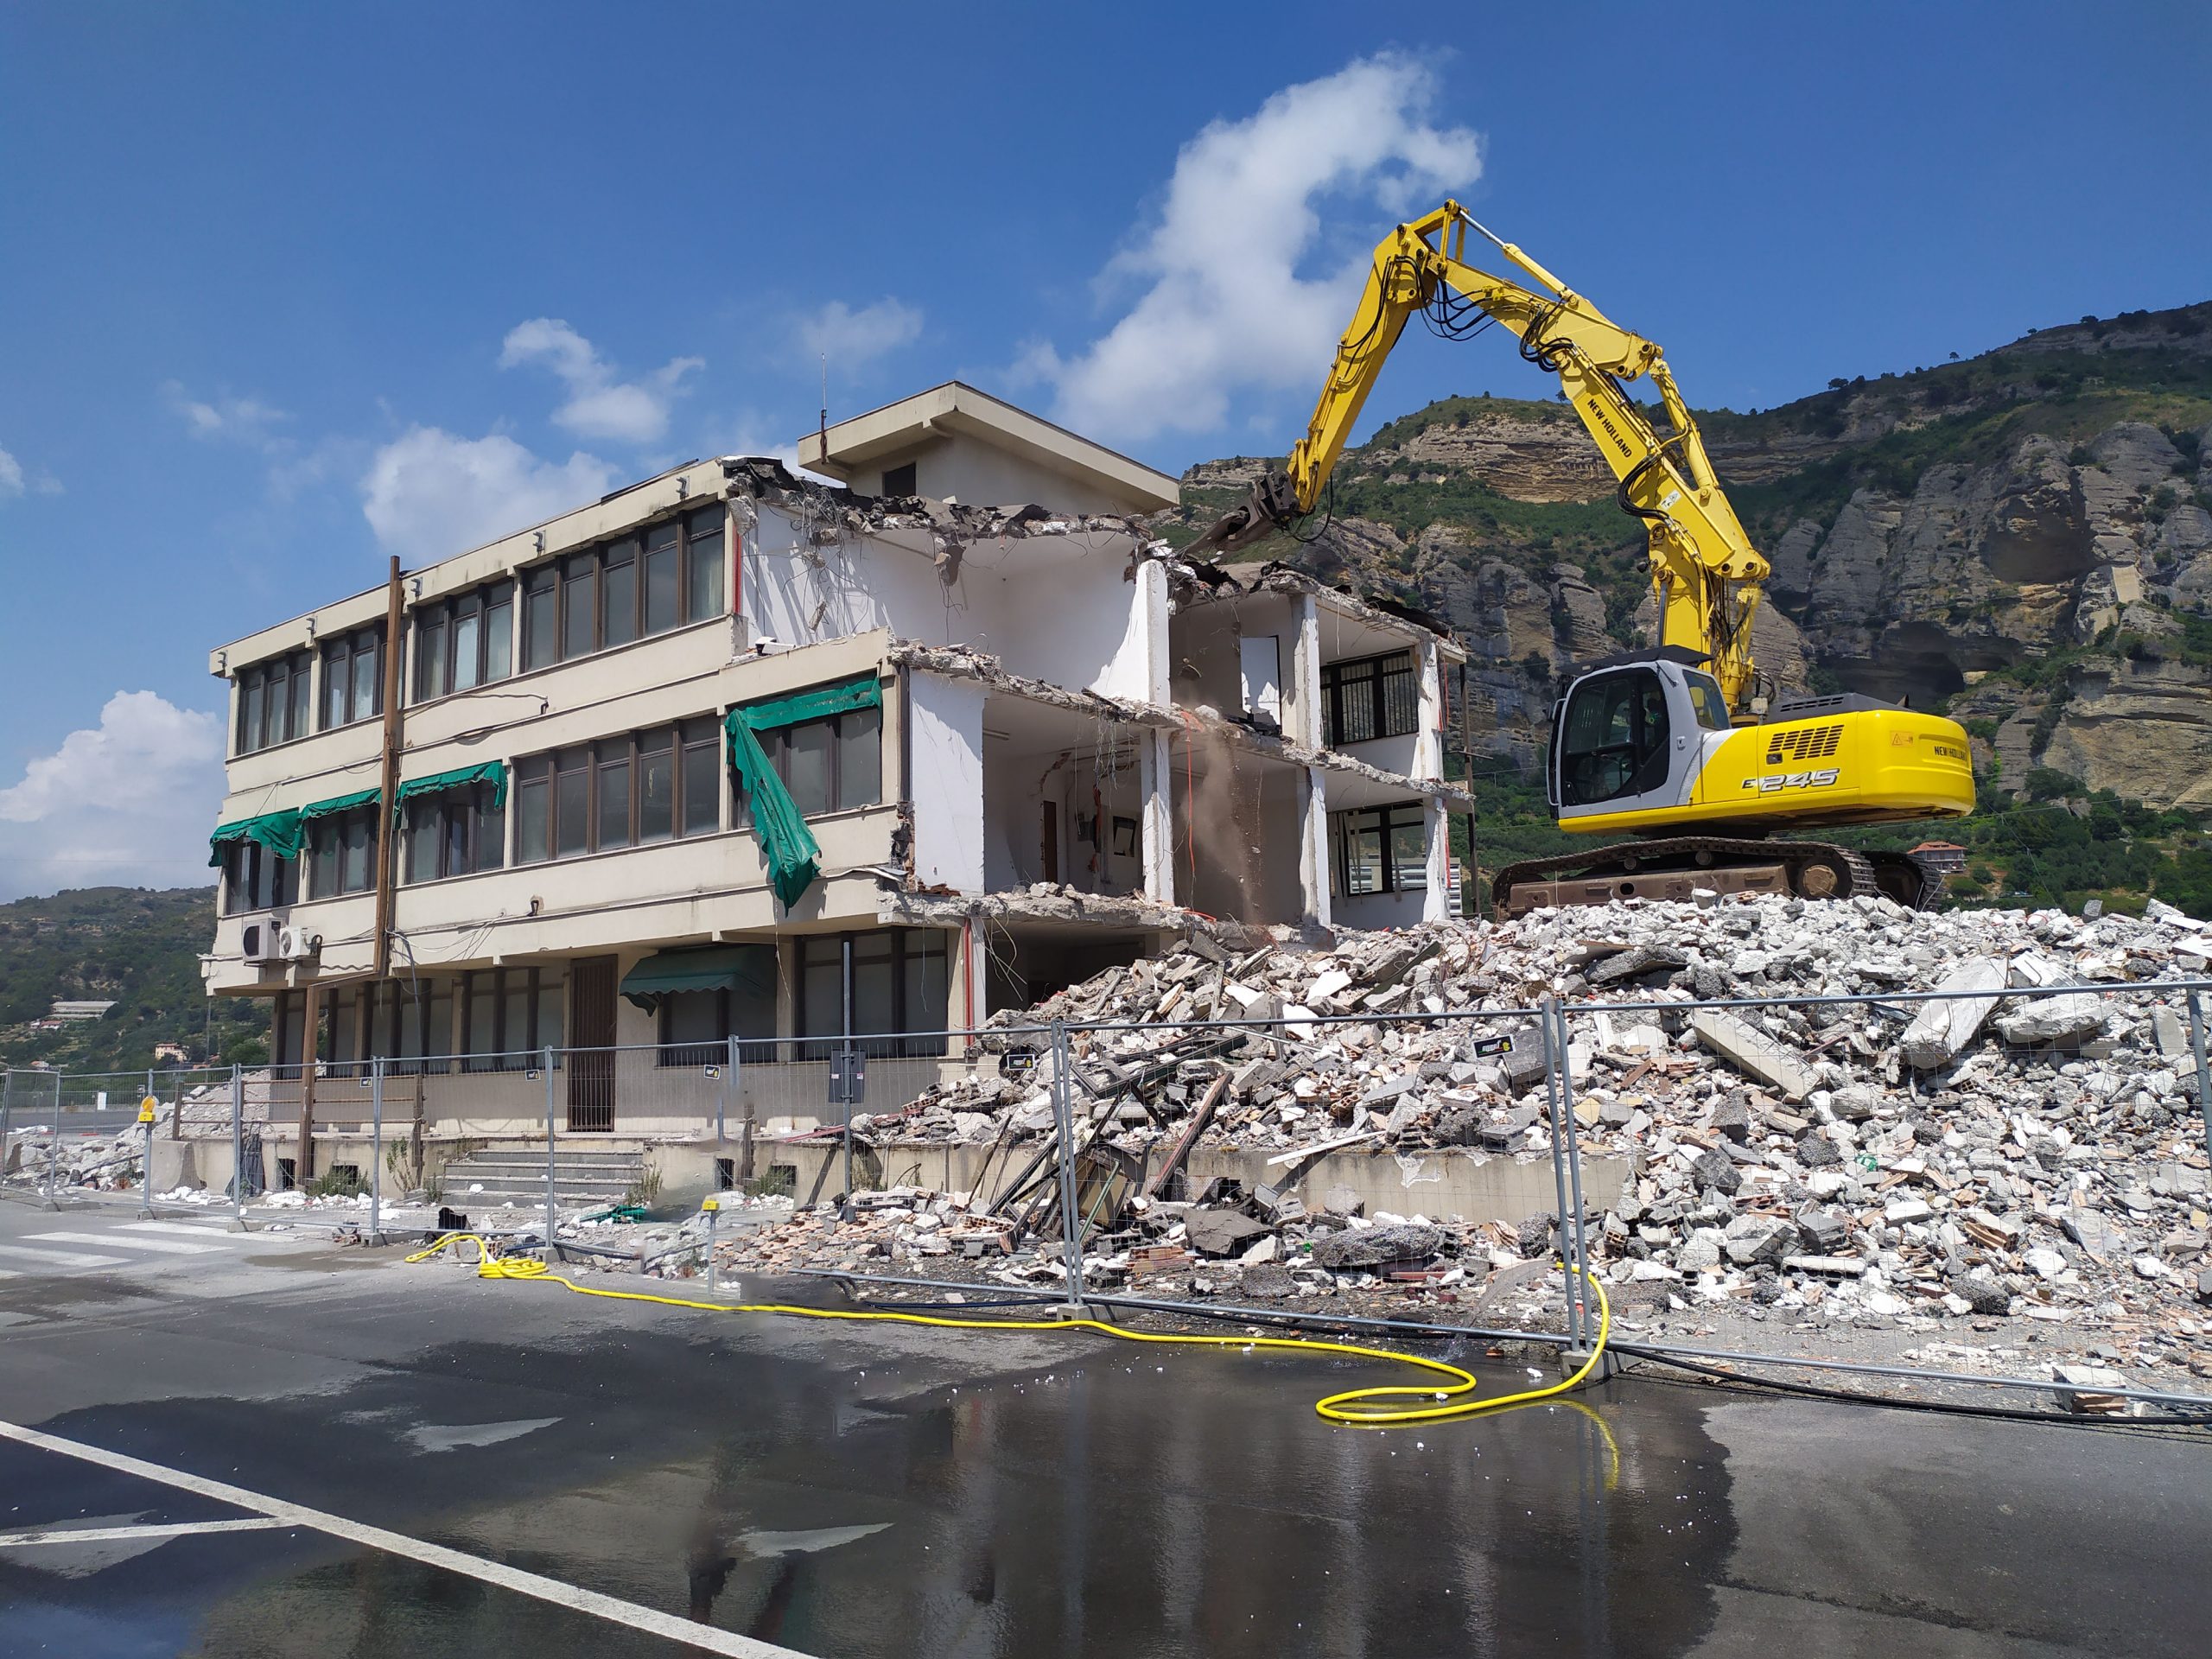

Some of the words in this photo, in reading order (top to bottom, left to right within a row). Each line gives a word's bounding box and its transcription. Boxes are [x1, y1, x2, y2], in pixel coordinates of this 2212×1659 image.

[1587, 398, 1605, 420] NEW
[1602, 418, 1632, 458] HOLLAND
[1934, 746, 1948, 756] NEW
[1948, 747, 1967, 761] HOLLA
